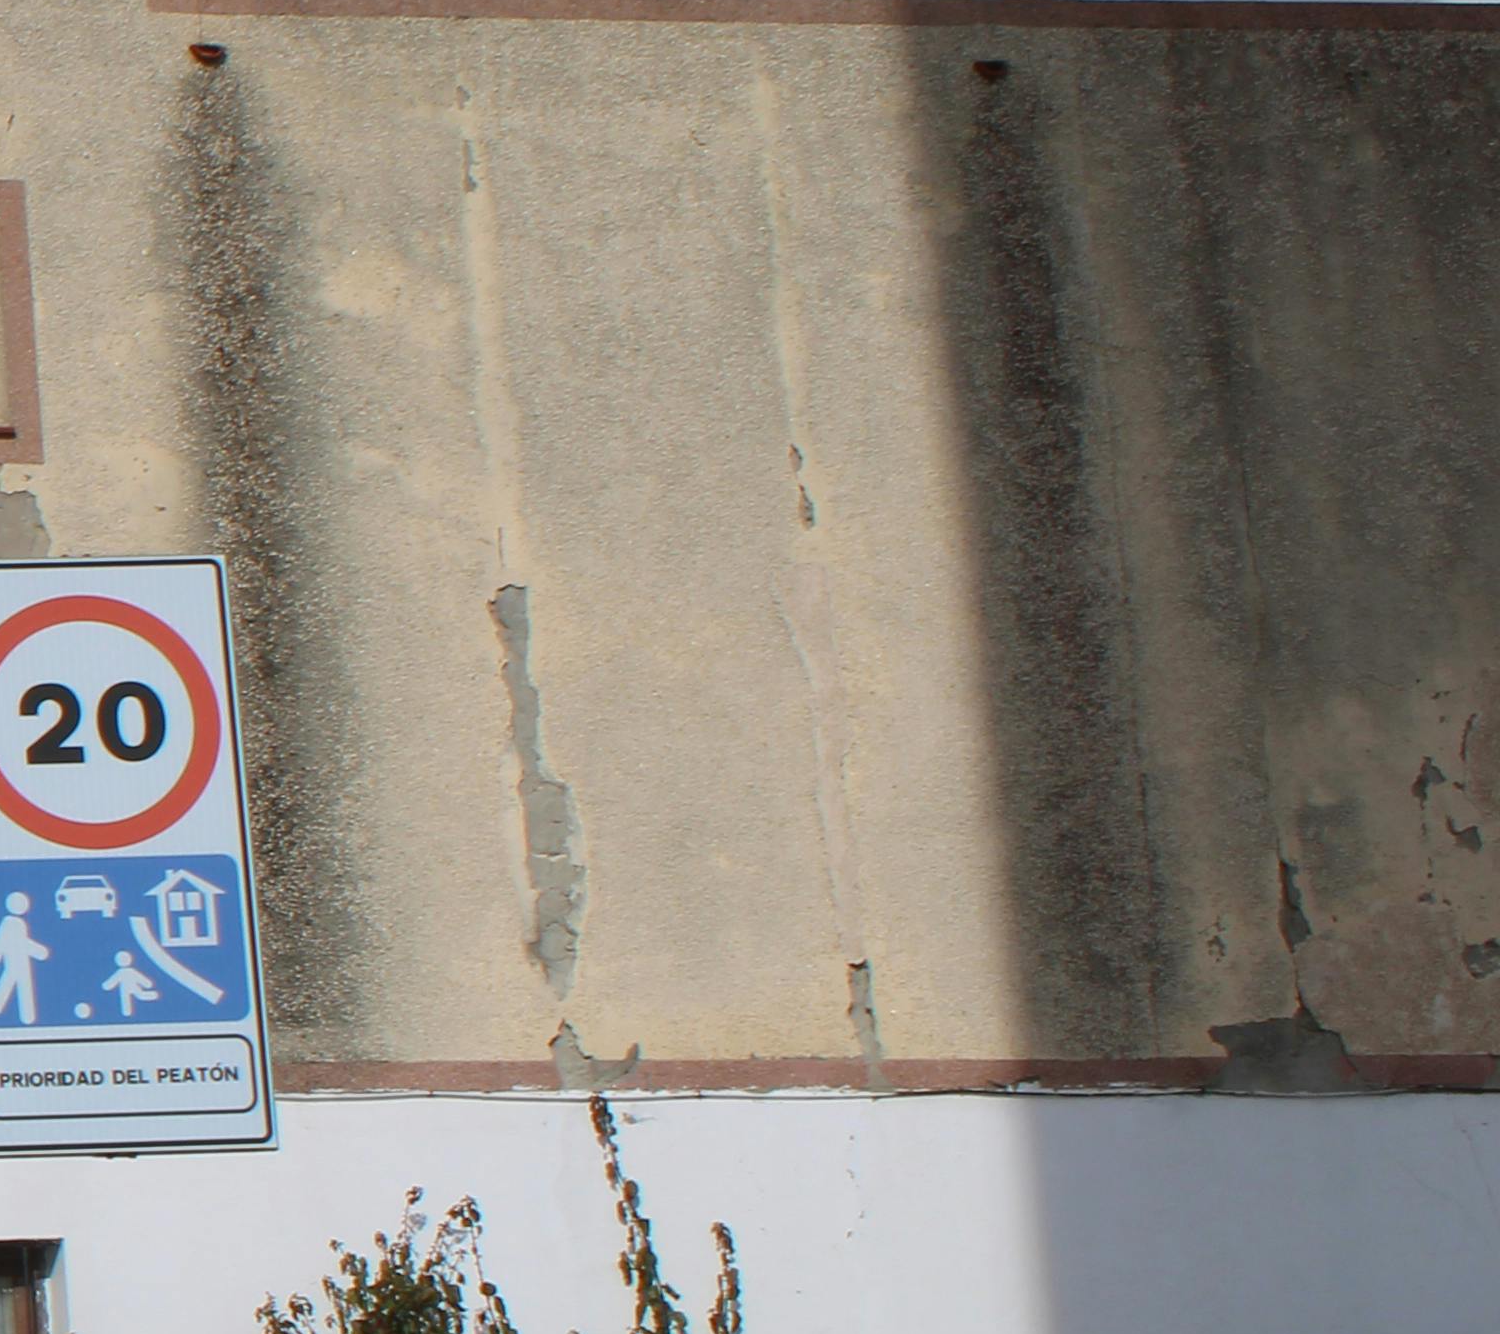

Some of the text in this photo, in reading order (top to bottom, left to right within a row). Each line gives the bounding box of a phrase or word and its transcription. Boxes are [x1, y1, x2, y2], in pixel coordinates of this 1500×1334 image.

[19, 681, 166, 764] 20
[0, 1062, 239, 1088] PRIORIDAD DEL PEATÓN
